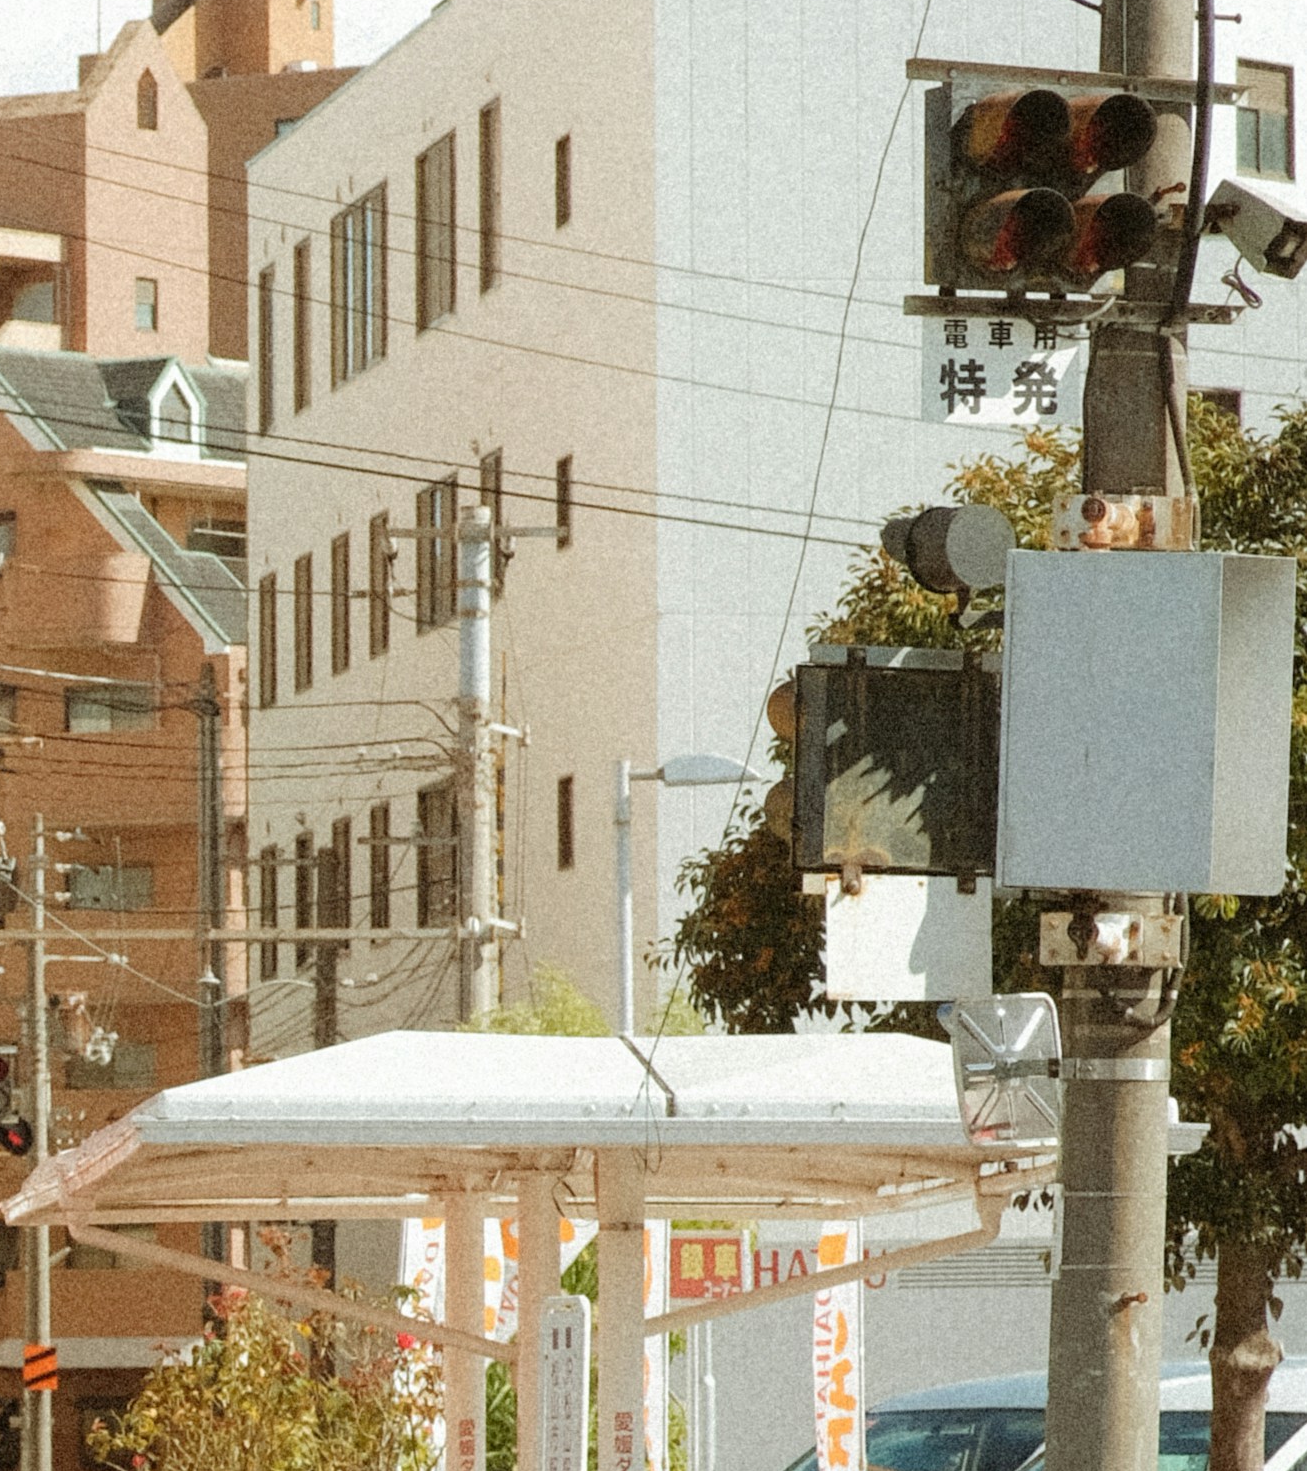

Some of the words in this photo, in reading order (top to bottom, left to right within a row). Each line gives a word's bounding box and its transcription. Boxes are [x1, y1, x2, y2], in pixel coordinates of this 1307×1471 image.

[944, 319, 1057, 350] 電車用
[940, 359, 1058, 415] 特発
